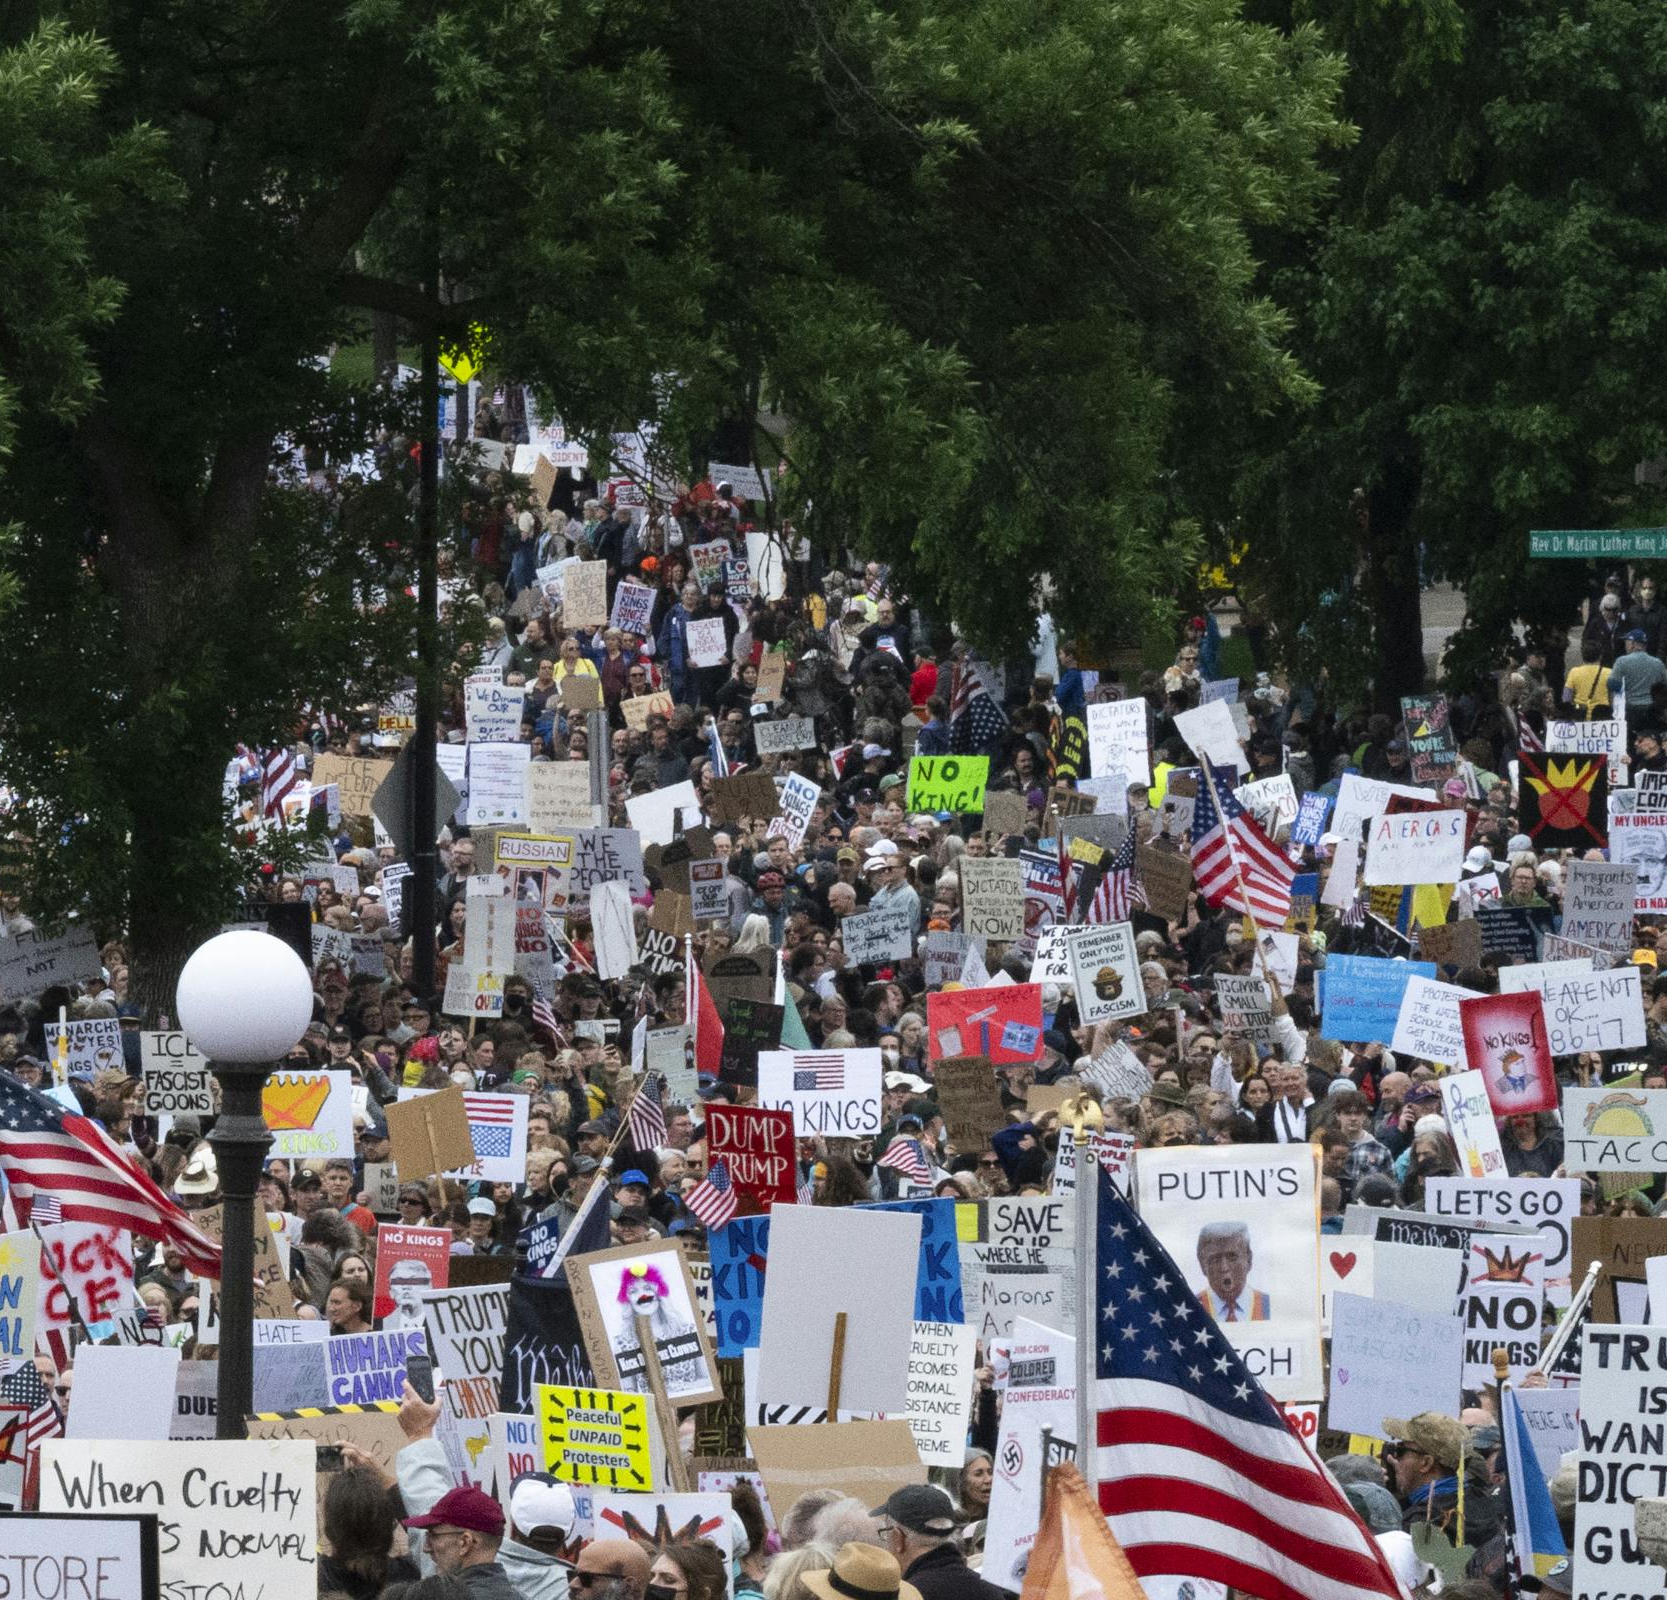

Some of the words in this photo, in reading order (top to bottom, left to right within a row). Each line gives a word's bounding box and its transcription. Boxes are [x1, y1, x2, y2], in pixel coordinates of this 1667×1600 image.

[1532, 537, 1549, 550] Rev
[1553, 537, 1562, 550] Dr
[1568, 537, 1597, 551] Martin
[1601, 537, 1631, 551] Luther
[1636, 538, 1655, 554] King
[916, 760, 960, 782] NO
[912, 787, 978, 811] KING!
[1077, 933, 1123, 950] REMEMBER
[1079, 948, 1099, 960] ONLY
[1101, 943, 1123, 956] YOU
[1090, 999, 1136, 1018] FASCISM
[146, 1071, 211, 1092] FASCIST
[146, 1092, 211, 1112] GOONS
[802, 1099, 880, 1132] KINGS
[711, 1115, 787, 1152] DUMP
[711, 1152, 787, 1188] TRUMP
[1158, 1168, 1299, 1201] PUTIN'S
[1436, 1190, 1512, 1215] LET'S
[1520, 1191, 1563, 1215] GO
[566, 1408, 622, 1426] Peaceful
[569, 1429, 622, 1448] UNPAID
[562, 1449, 631, 1468] Protesters
[53, 1460, 165, 1511] When
[181, 1468, 302, 1521] Cruelty
